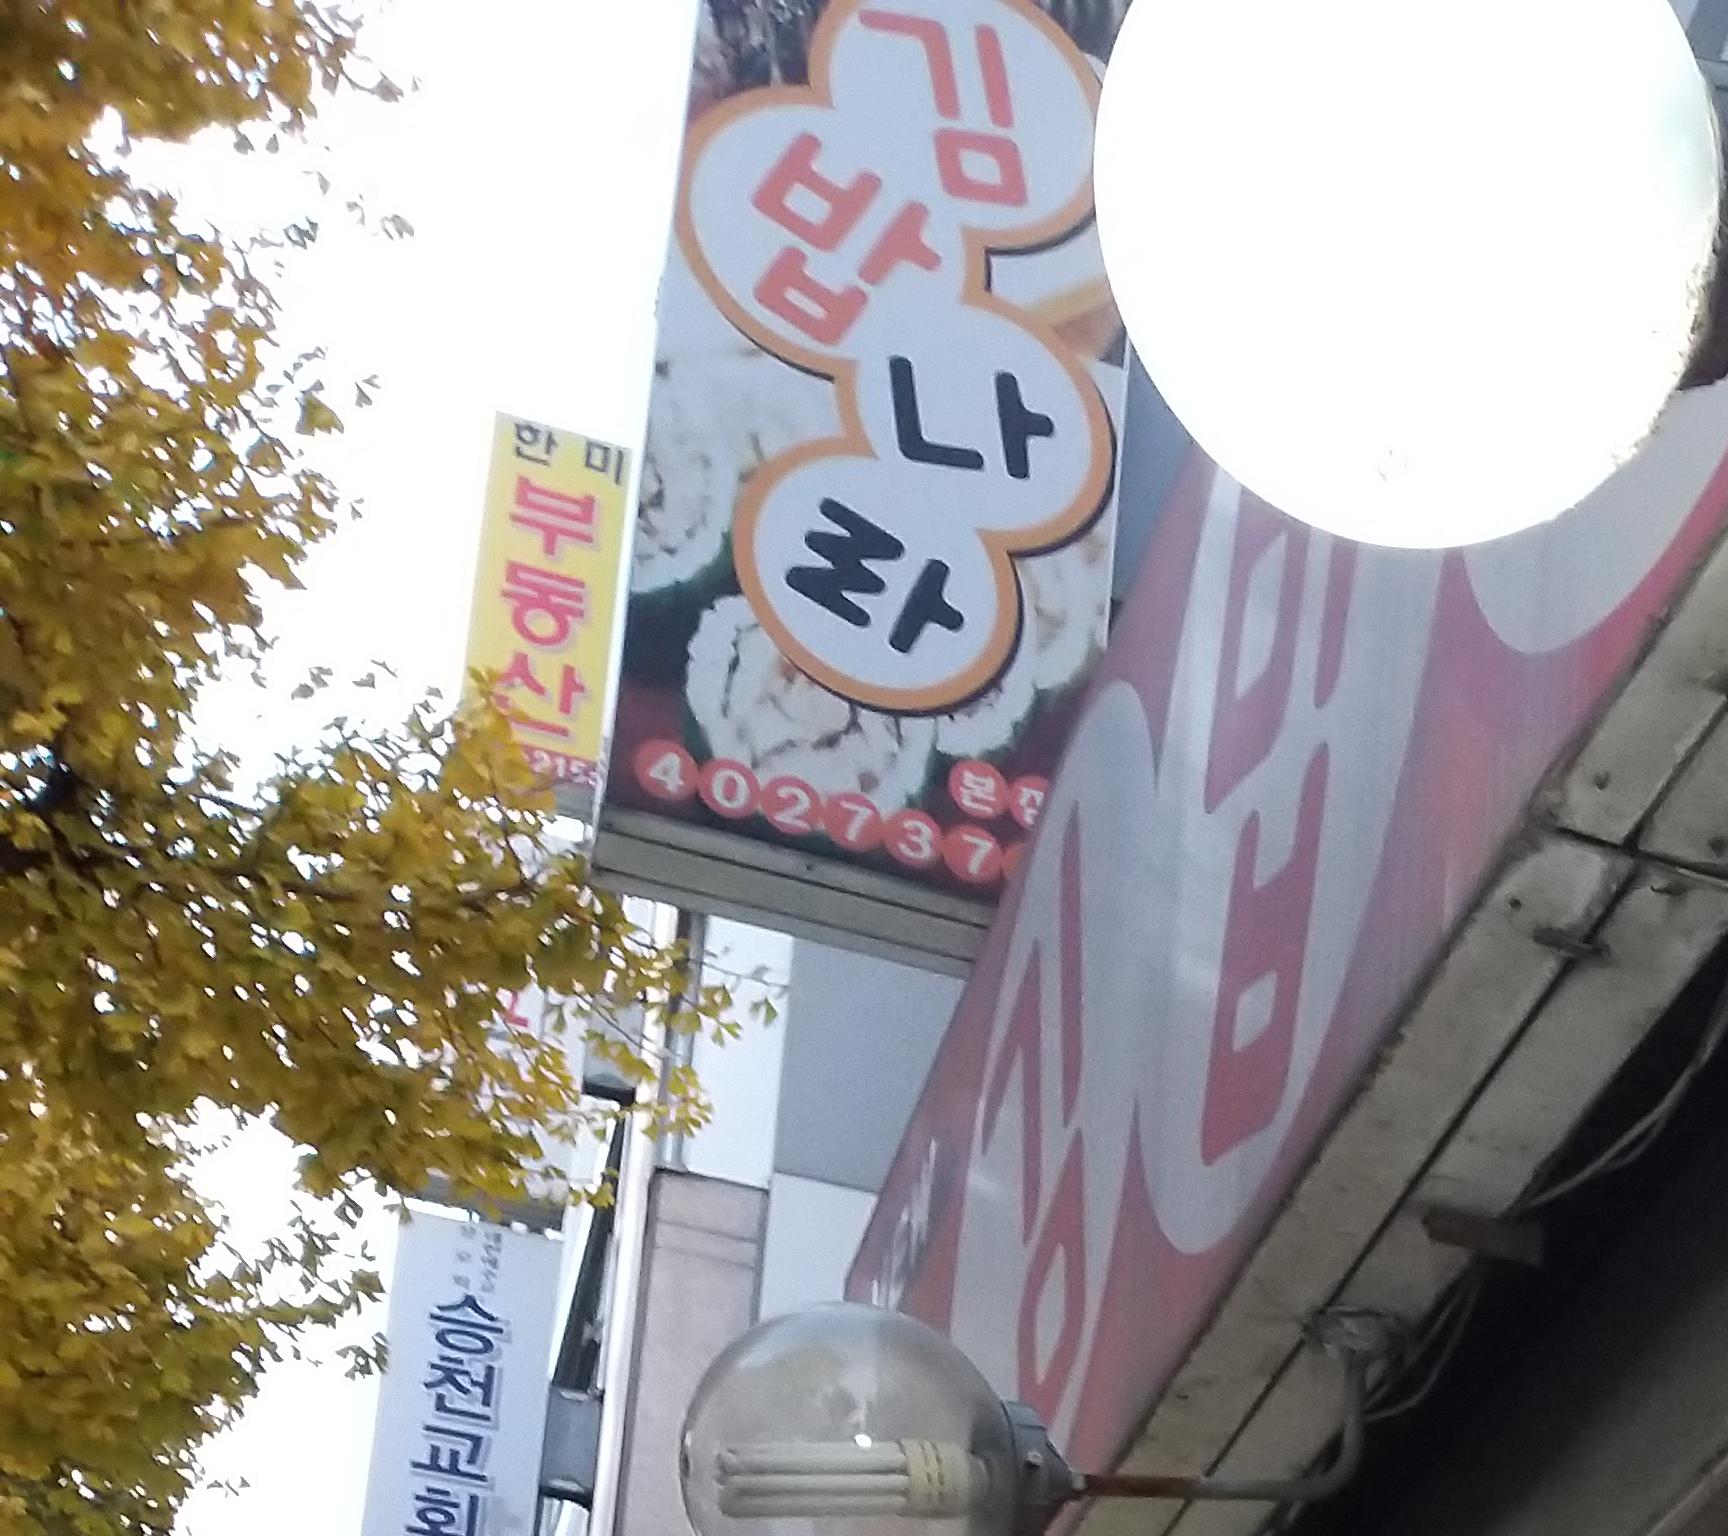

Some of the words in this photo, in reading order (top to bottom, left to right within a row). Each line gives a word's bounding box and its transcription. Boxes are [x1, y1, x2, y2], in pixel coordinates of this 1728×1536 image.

[513, 420, 624, 486] 한미
[750, 6, 1056, 655] 김밥나라
[500, 474, 598, 740] 부동산
